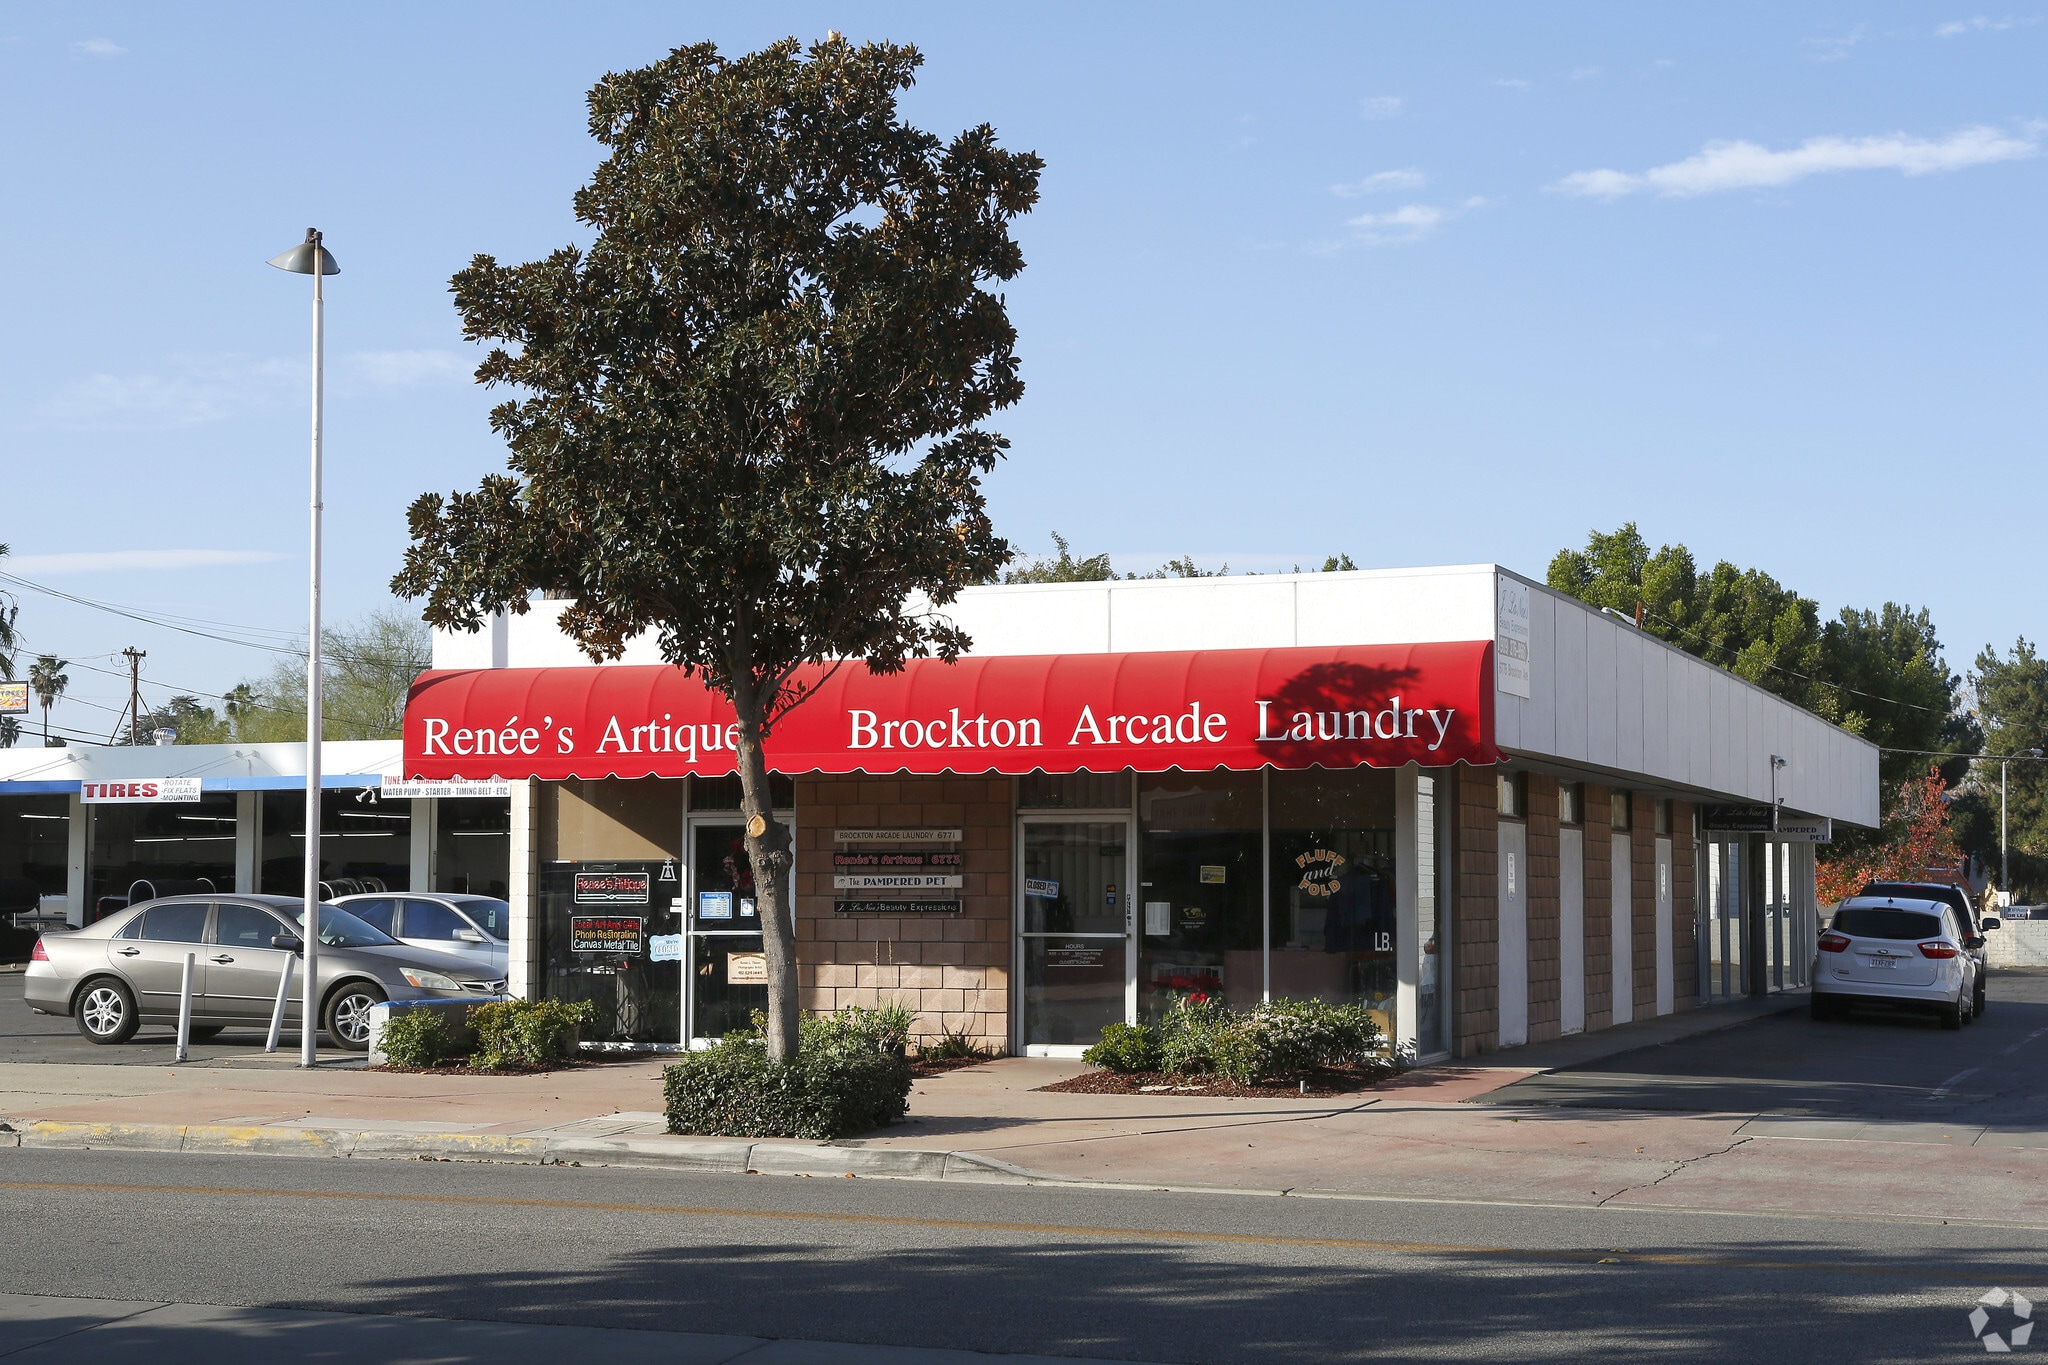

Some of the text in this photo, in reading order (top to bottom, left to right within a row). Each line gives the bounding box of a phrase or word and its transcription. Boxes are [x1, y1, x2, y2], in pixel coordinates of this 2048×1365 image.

[846, 696, 1454, 751] Brockton Arcade Laundry
[421, 713, 739, 763] Renée's Artique
[384, 776, 401, 785] TUNE
[83, 782, 158, 798] TIRES
[382, 787, 403, 796] WATER
[403, 787, 421, 796] PUMP
[425, 787, 451, 796] STARTER
[456, 787, 477, 796] TIMING
[478, 787, 491, 796] BELT
[496, 787, 509, 796] ETC.
[937, 831, 956, 839] 6771
[931, 854, 960, 865] 6773
[1295, 849, 1346, 868] FLUFF
[1302, 860, 1336, 881] and
[848, 877, 948, 886] The PAMPERED PET
[1026, 880, 1047, 891] CLOSED
[1298, 879, 1341, 896] FOLD
[880, 903, 907, 912] Beauty
[910, 903, 957, 912] Expressions
[575, 930, 638, 941] Photo Restoration
[573, 939, 602, 950] Canvas
[625, 940, 639, 950] Tile
[1374, 932, 1393, 951] LB.
